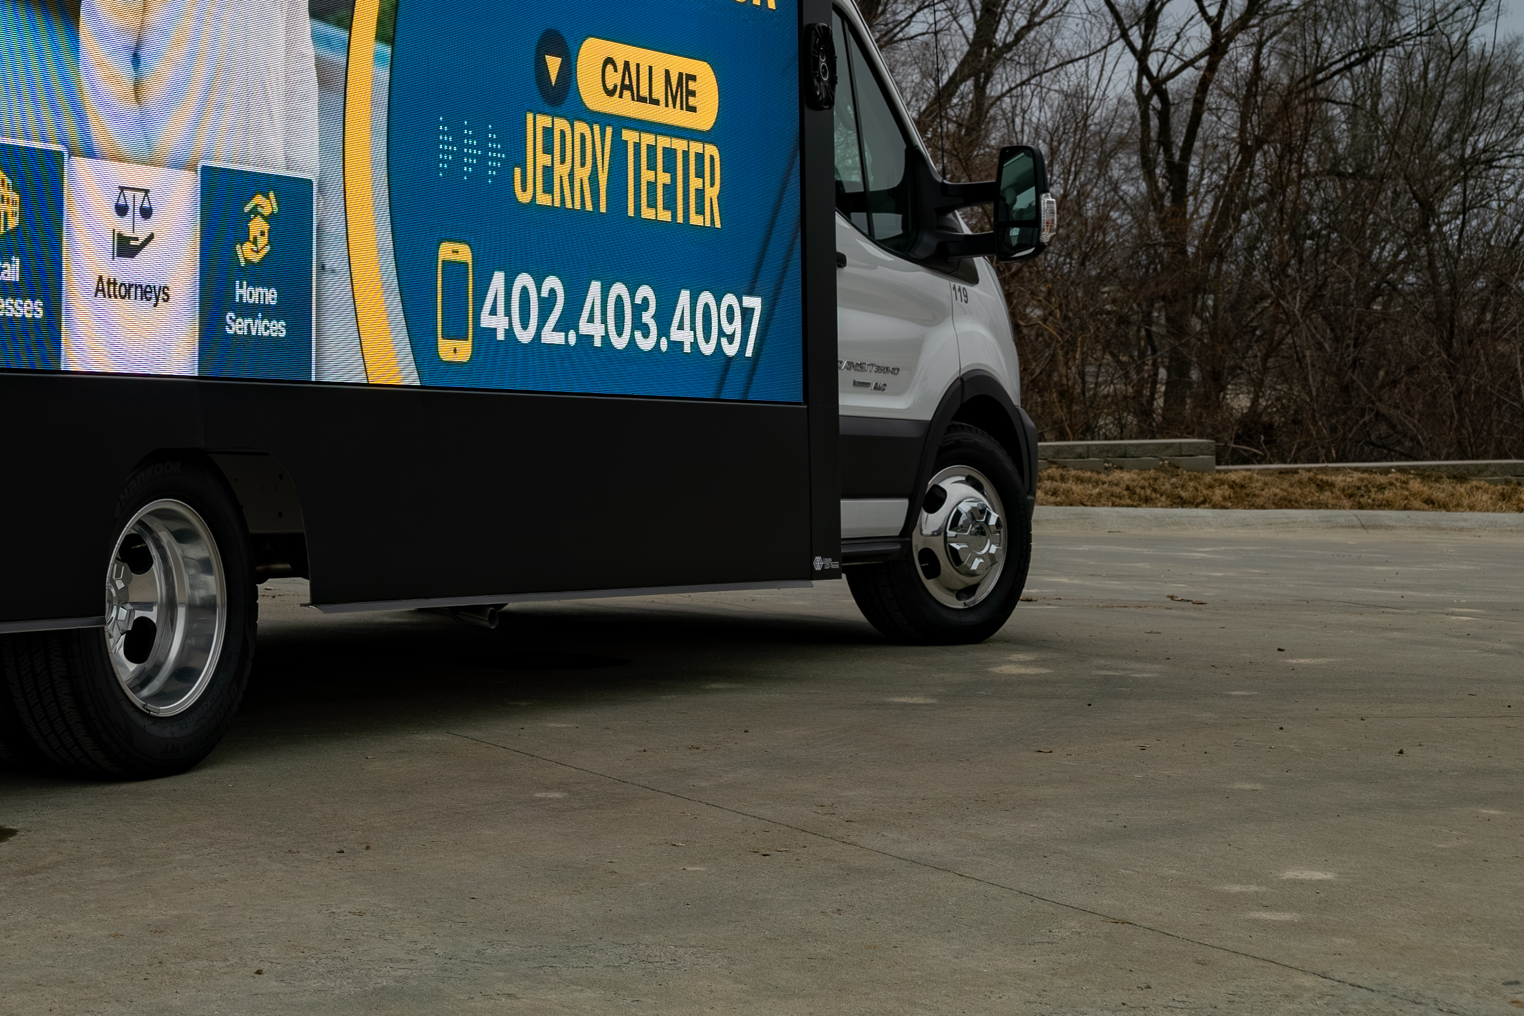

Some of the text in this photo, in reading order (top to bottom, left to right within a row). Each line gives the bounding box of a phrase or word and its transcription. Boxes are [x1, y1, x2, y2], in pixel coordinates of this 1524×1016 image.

[601, 55, 698, 114] CALL ME
[513, 111, 722, 230] JERRY TEETER
[94, 275, 170, 308] Attorneys
[234, 279, 278, 306] Home
[952, 283, 969, 305] 119
[225, 311, 286, 339] Services
[479, 269, 763, 359] 402.403.4097
